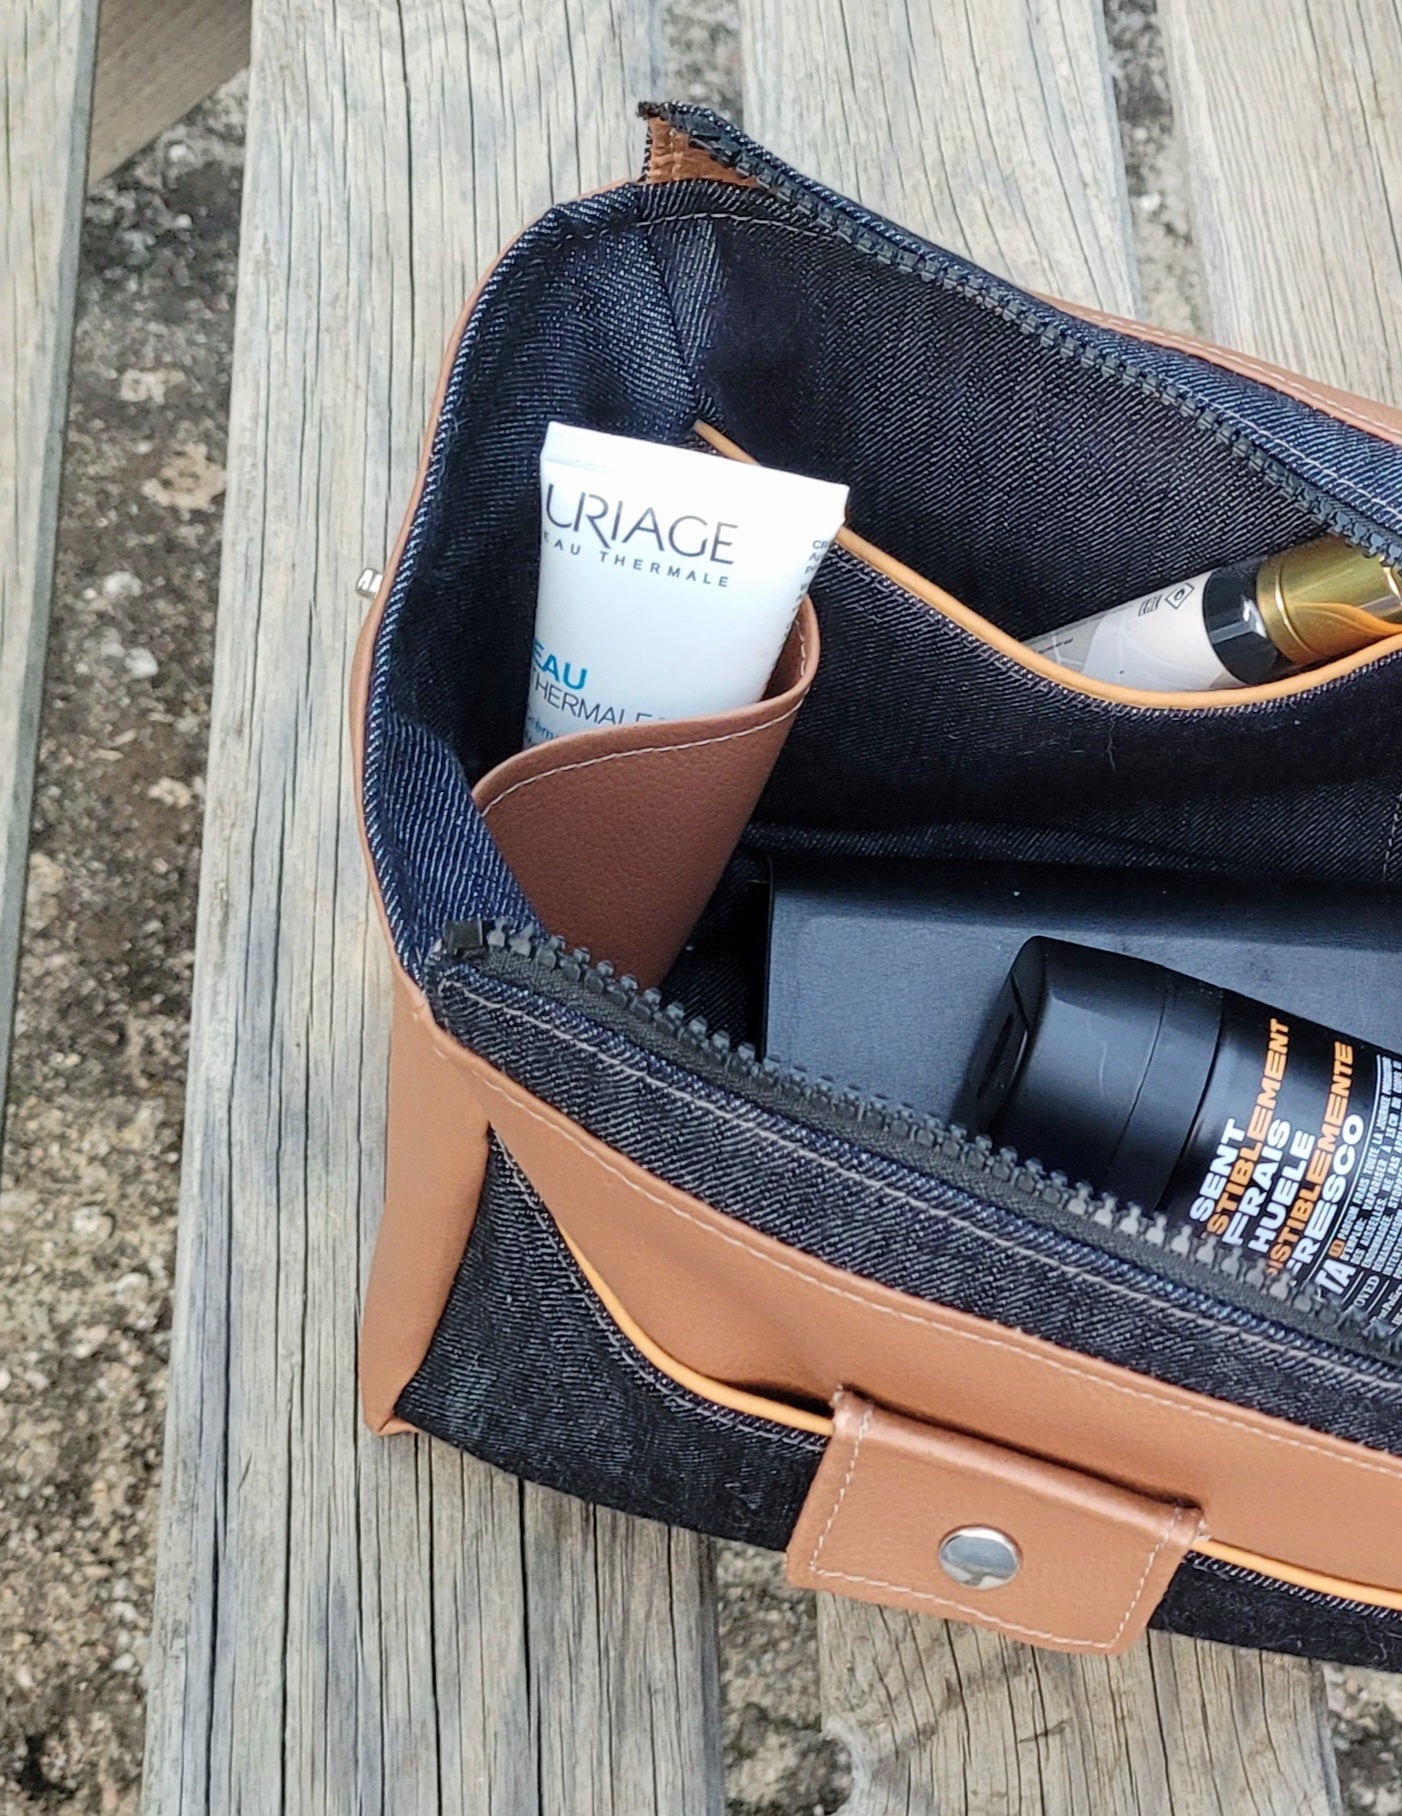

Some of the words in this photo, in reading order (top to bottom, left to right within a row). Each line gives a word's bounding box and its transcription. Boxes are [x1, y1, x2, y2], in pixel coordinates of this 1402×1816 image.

[546, 483, 739, 566] URIAGE
[543, 530, 582, 556] EAU
[598, 550, 730, 588] THERMALE
[532, 641, 588, 690] EAU
[1207, 1018, 1288, 1234] STIBLEMENT
[1189, 1115, 1248, 1222] SENT
[1222, 1115, 1292, 1247] FRAIS
[1248, 1127, 1316, 1253] HUELE
[1337, 1206, 1359, 1239] PARFUM
[1352, 1176, 1370, 1204] FRAIS
[1362, 1145, 1380, 1175] TOUTE
[1372, 1131, 1384, 1145] LA
[1362, 1158, 1388, 1209] VAPORISER
[1380, 1176, 1394, 1192] NE
[1386, 1154, 1401, 1175] PAS
[1314, 1259, 1355, 1293] TA
[1352, 1275, 1379, 1306] OVED
